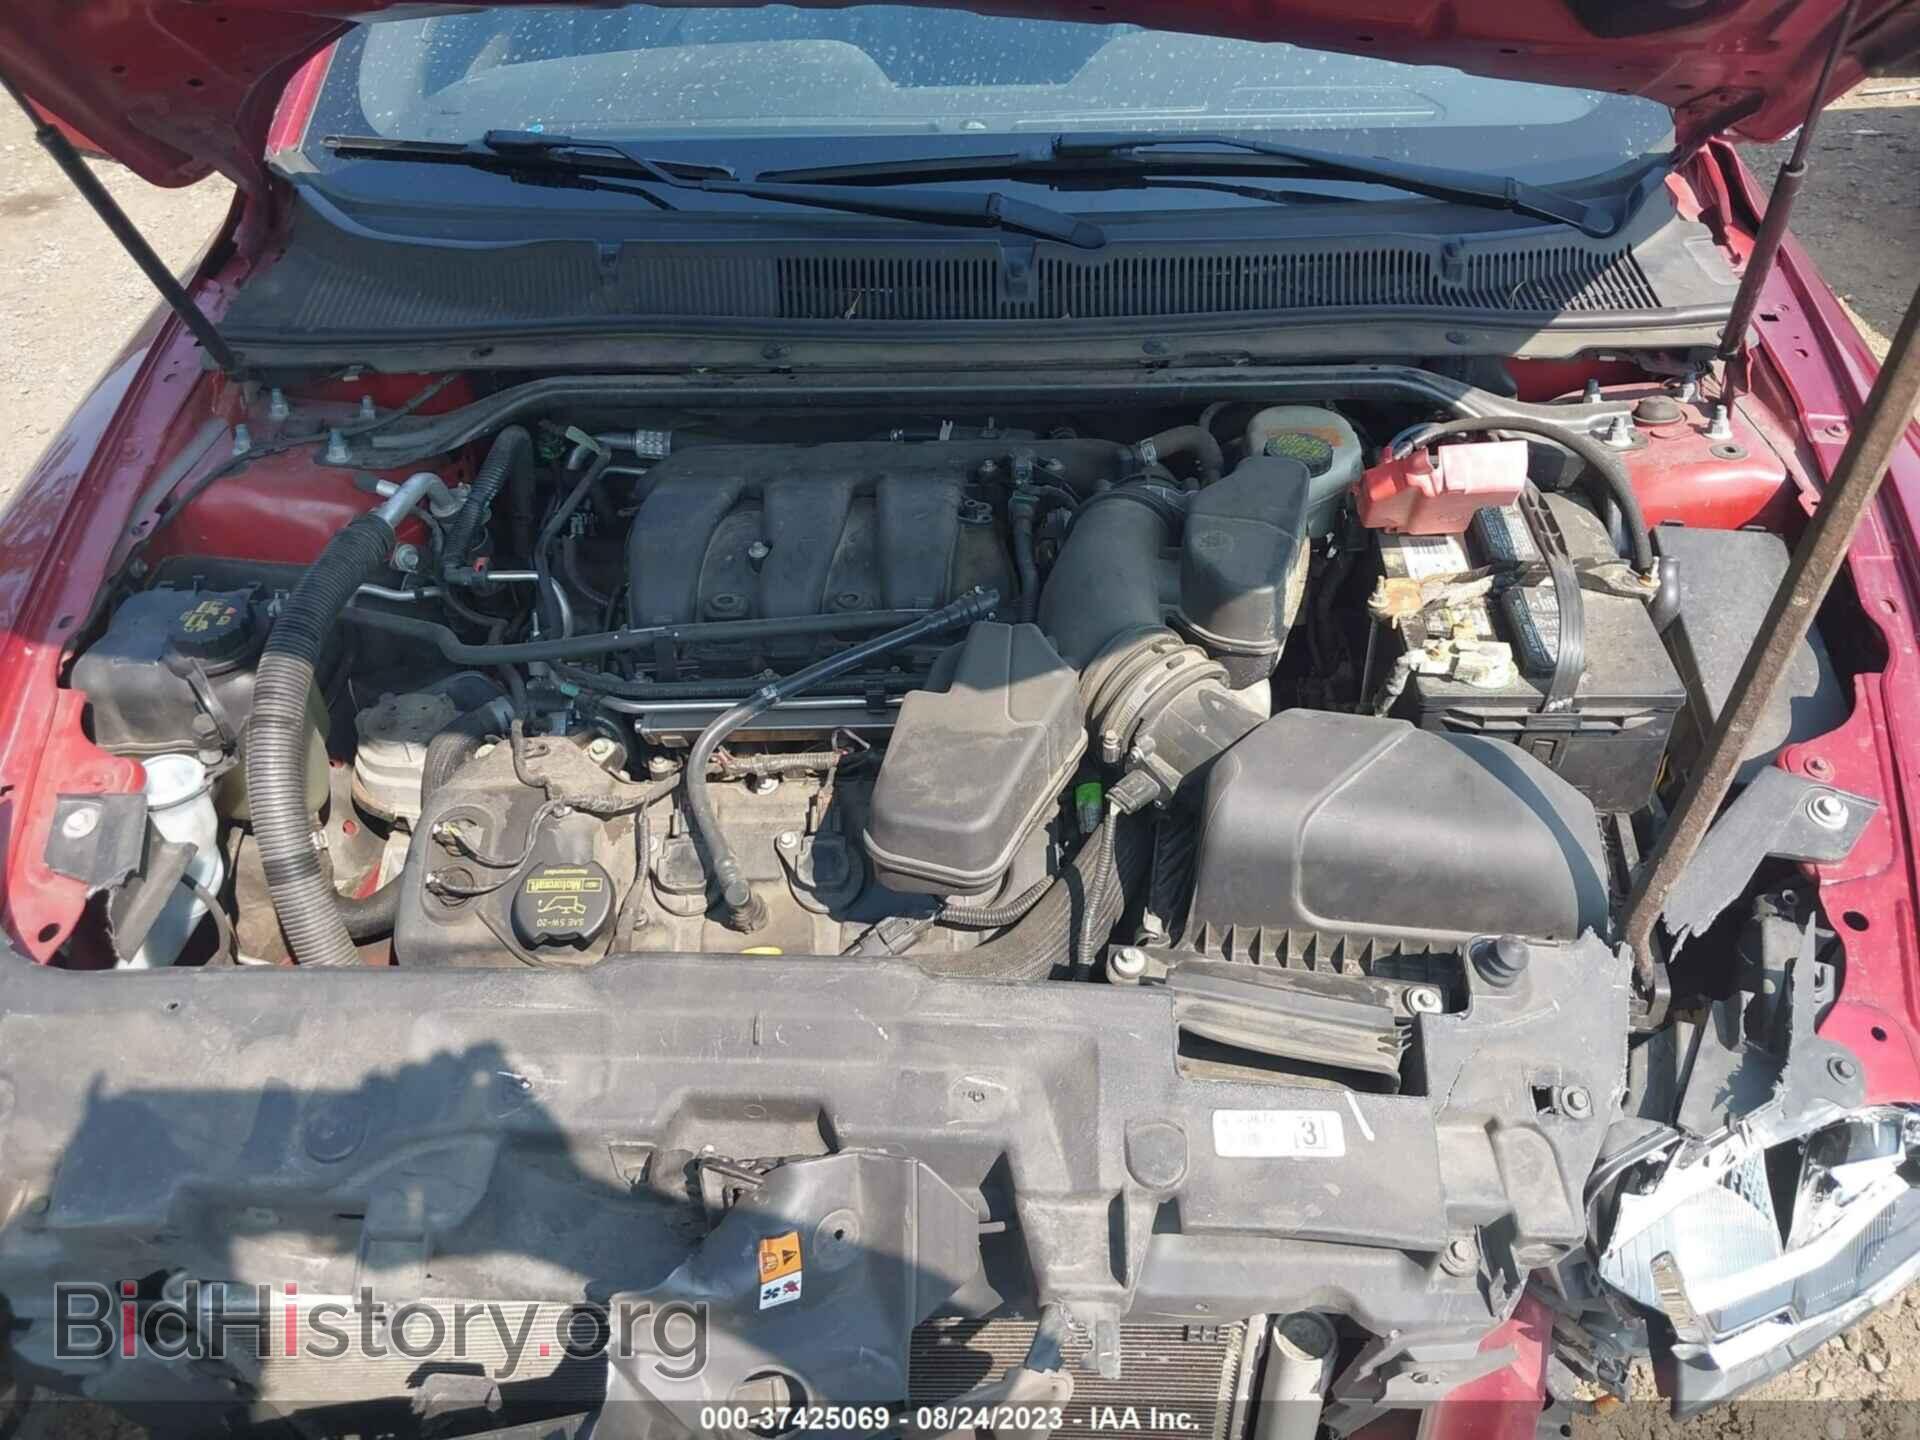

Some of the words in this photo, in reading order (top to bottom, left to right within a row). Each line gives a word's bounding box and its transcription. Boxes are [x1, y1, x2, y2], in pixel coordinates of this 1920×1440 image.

[537, 918, 565, 928] 5W-20
[567, 918, 584, 927] SAE
[1302, 1121, 1317, 1145] 3
